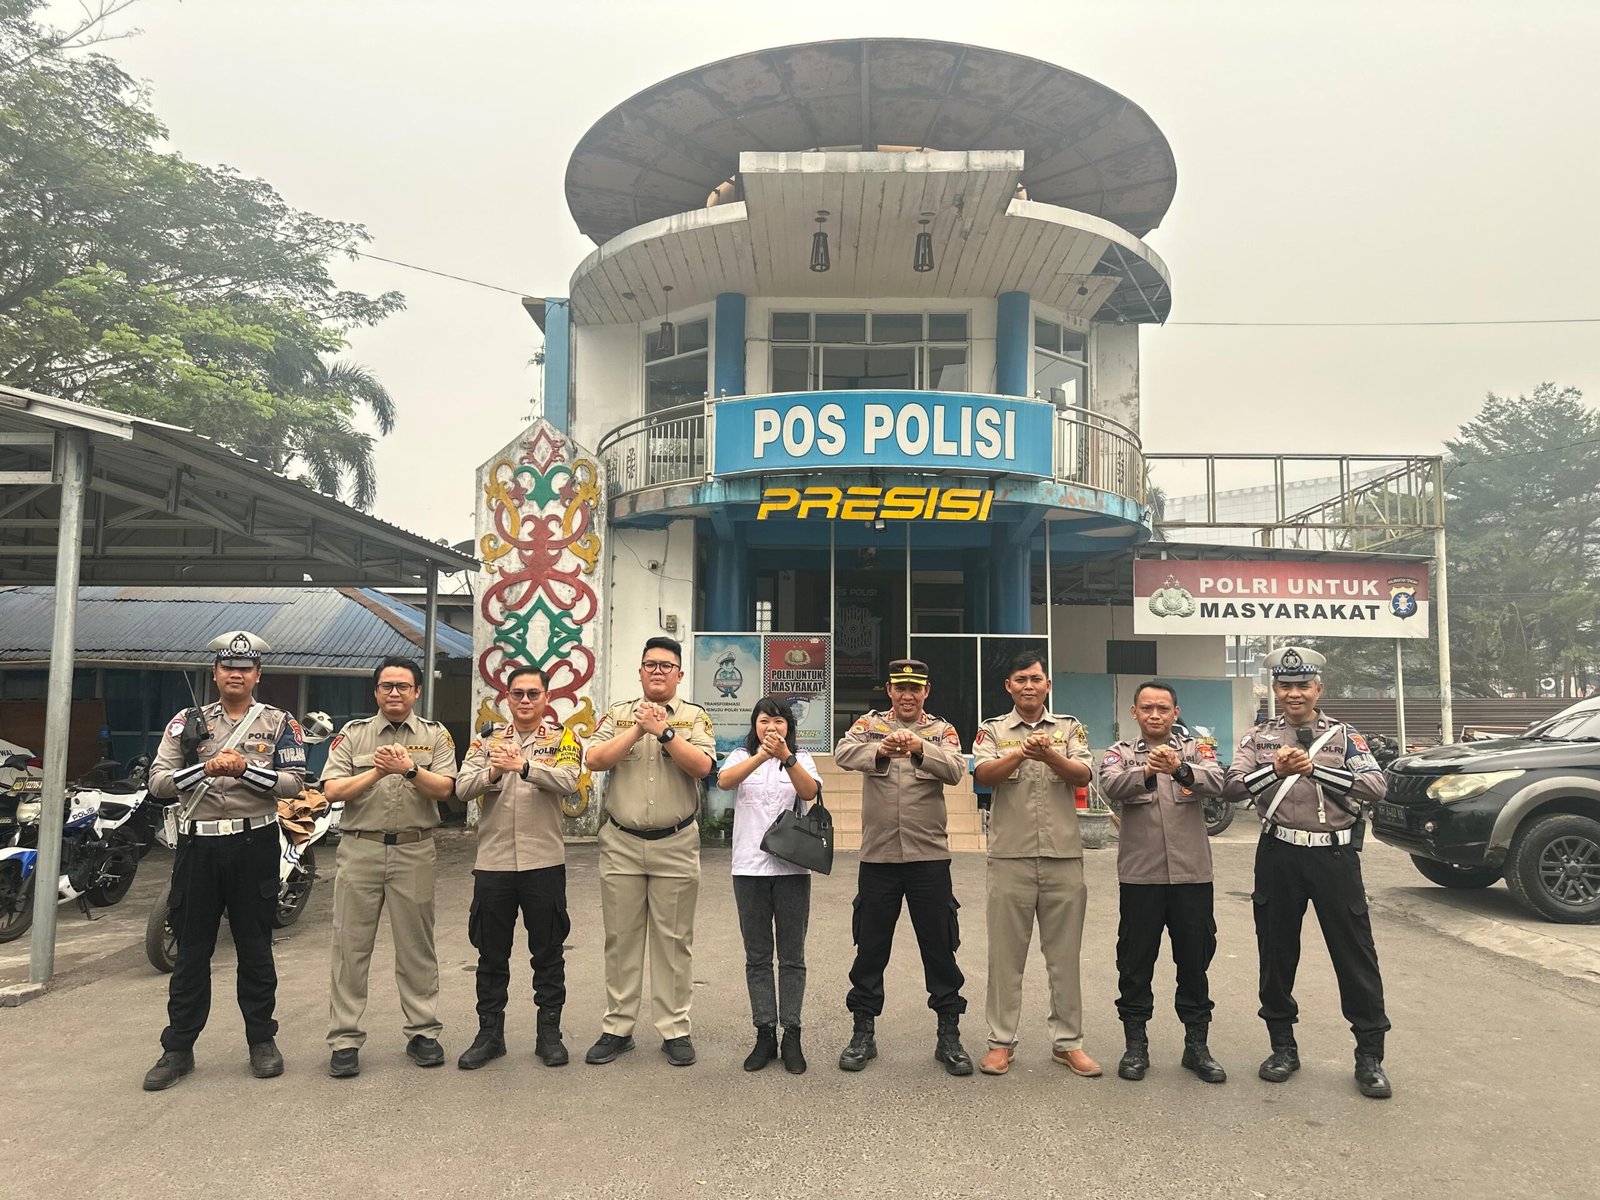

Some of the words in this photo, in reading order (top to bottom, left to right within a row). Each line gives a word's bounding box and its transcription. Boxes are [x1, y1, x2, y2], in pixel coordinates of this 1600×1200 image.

[753, 402, 847, 459] POS
[863, 402, 1017, 460] POLISI
[757, 486, 995, 522] PRESISI
[1200, 577, 1277, 594] POLRI
[1288, 578, 1380, 596] UNTUK
[1200, 602, 1380, 621] MASYARAKAT
[771, 669, 794, 680] POLRI
[796, 669, 823, 680] UNTUK
[771, 681, 823, 692] MASYRAKAT
[248, 732, 275, 741] POLRI
[533, 746, 557, 756] POLRI
[1321, 746, 1344, 754] OLRI
[72, 806, 96, 820] POLISI
